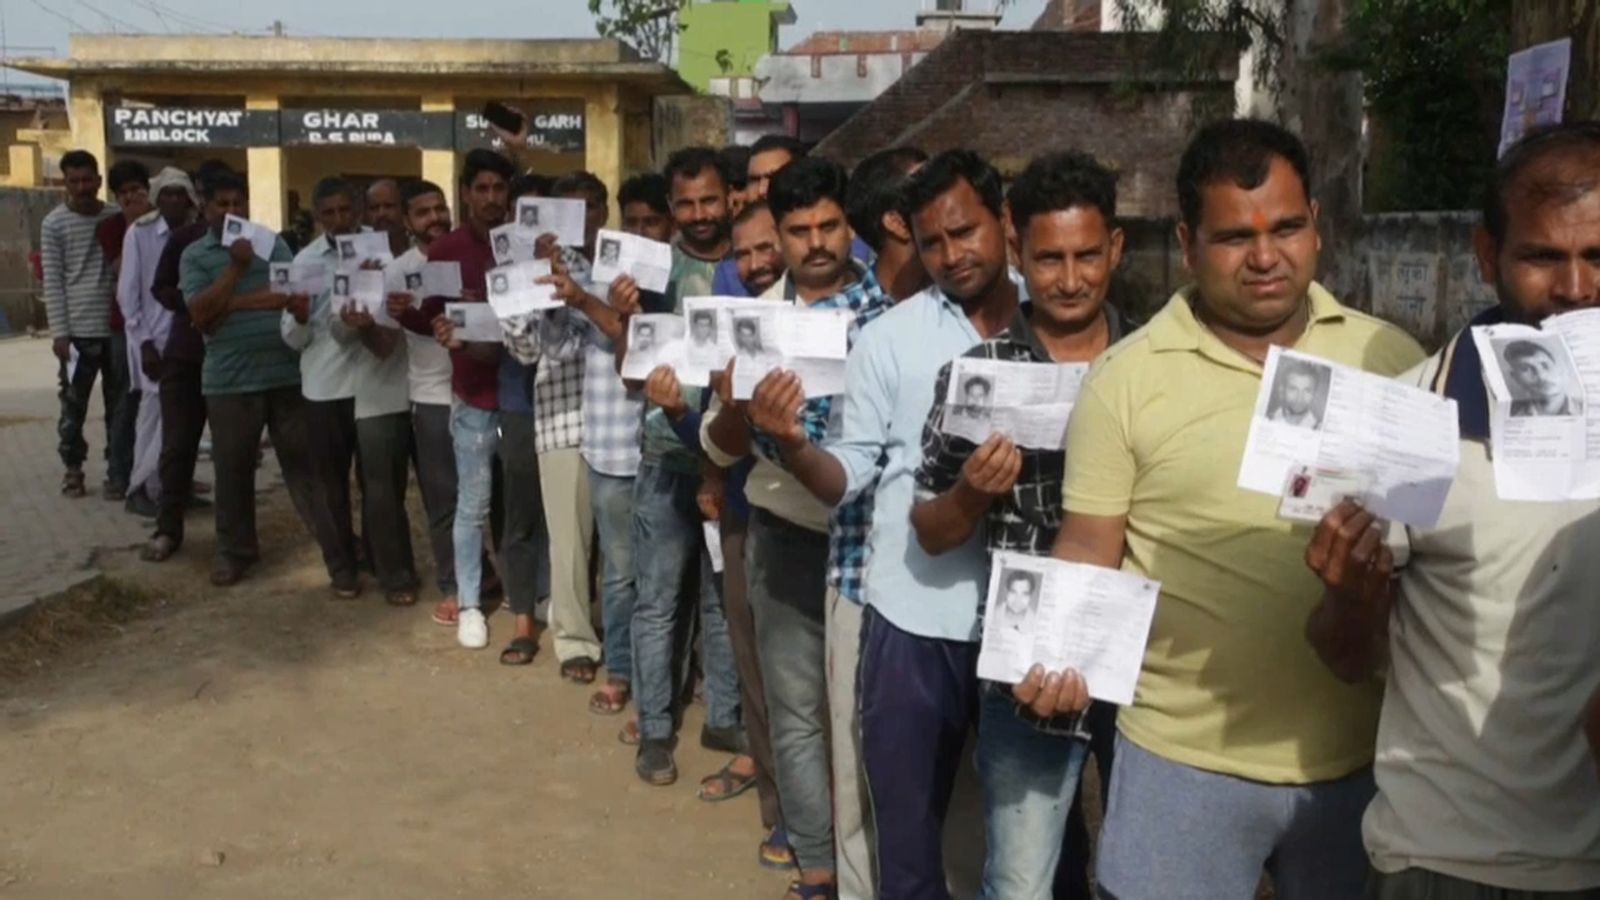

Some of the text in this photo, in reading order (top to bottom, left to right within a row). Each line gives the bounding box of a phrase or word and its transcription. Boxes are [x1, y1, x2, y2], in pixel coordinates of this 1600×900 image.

[114, 108, 242, 127] PANCHYAT
[303, 111, 379, 129] GHAR
[534, 114, 582, 129] GARH
[149, 127, 210, 143] BLOCK
